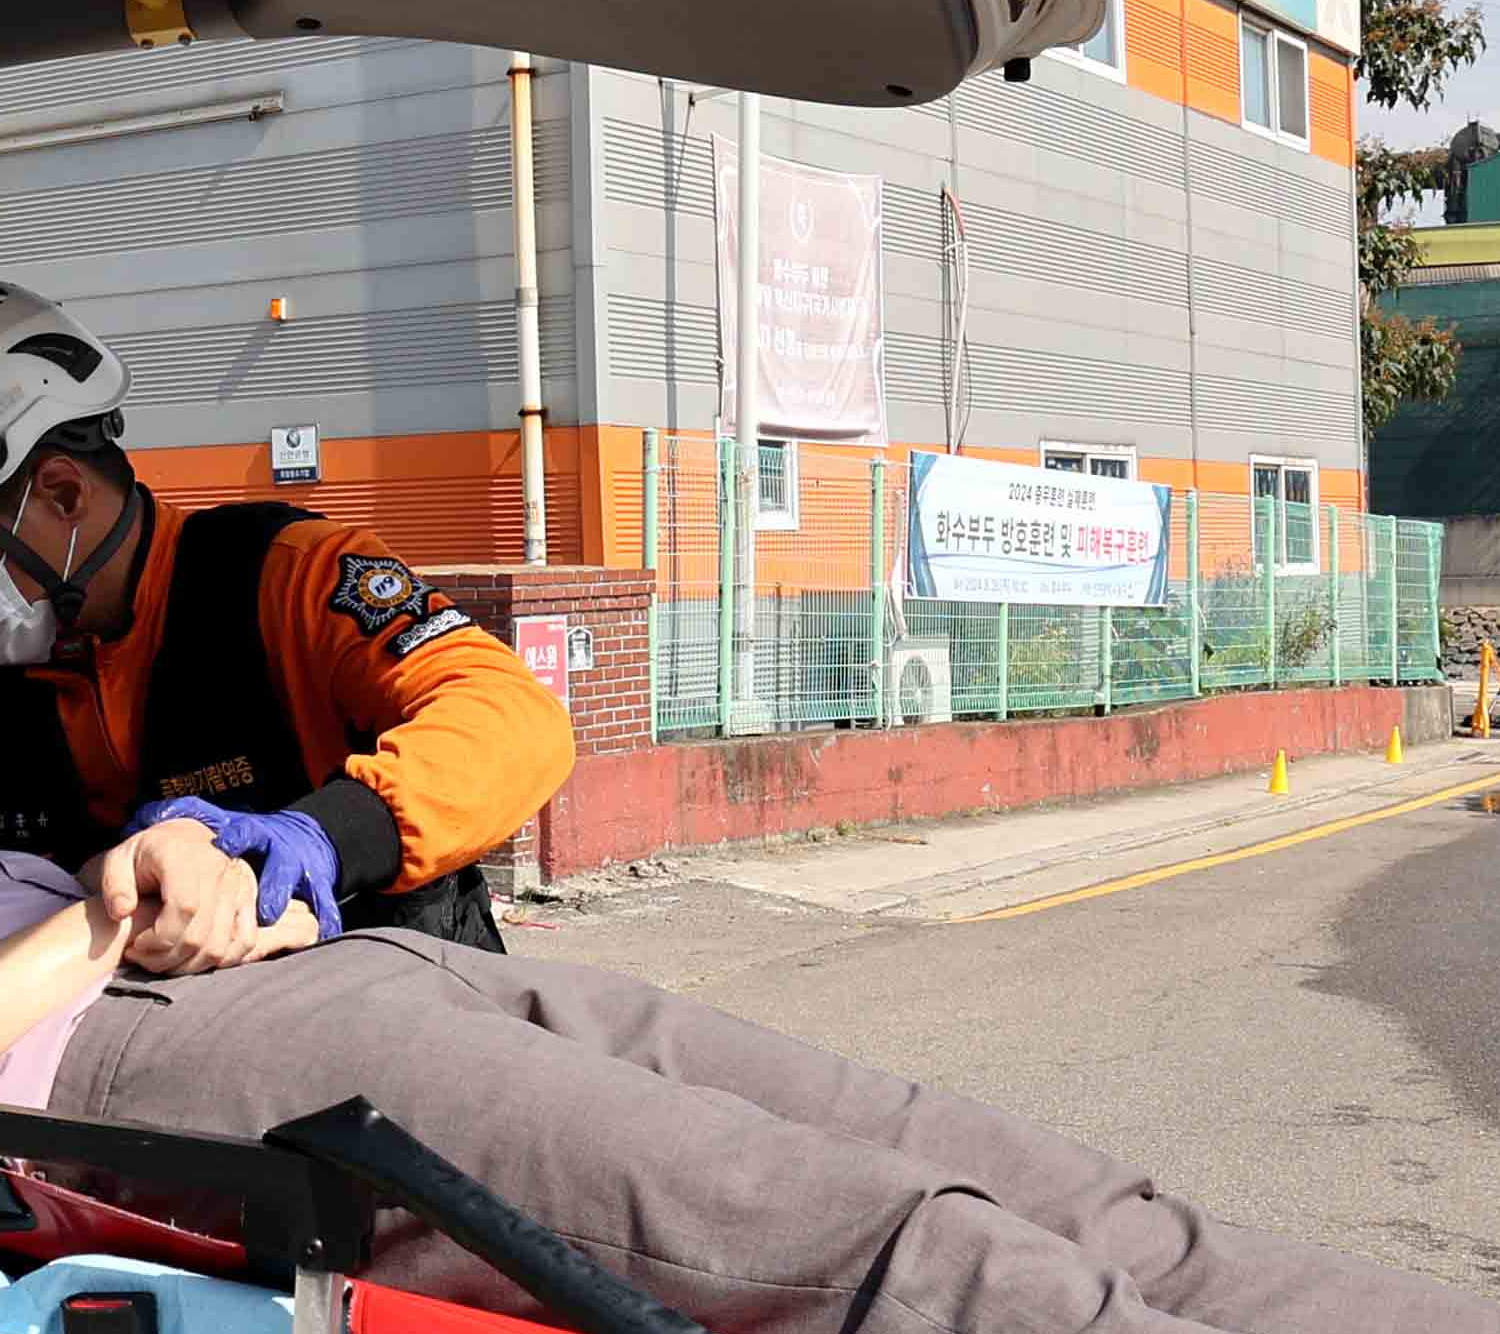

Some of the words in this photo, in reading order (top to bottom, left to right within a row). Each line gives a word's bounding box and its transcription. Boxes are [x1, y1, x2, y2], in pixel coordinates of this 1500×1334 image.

[1008, 482, 1033, 502] 2024
[935, 510, 996, 553] 화수부두
[1000, 517, 1056, 557] 방호훈련
[1060, 523, 1073, 559] 및
[1076, 526, 1150, 565] 피해복구훈련
[373, 575, 395, 596] 119
